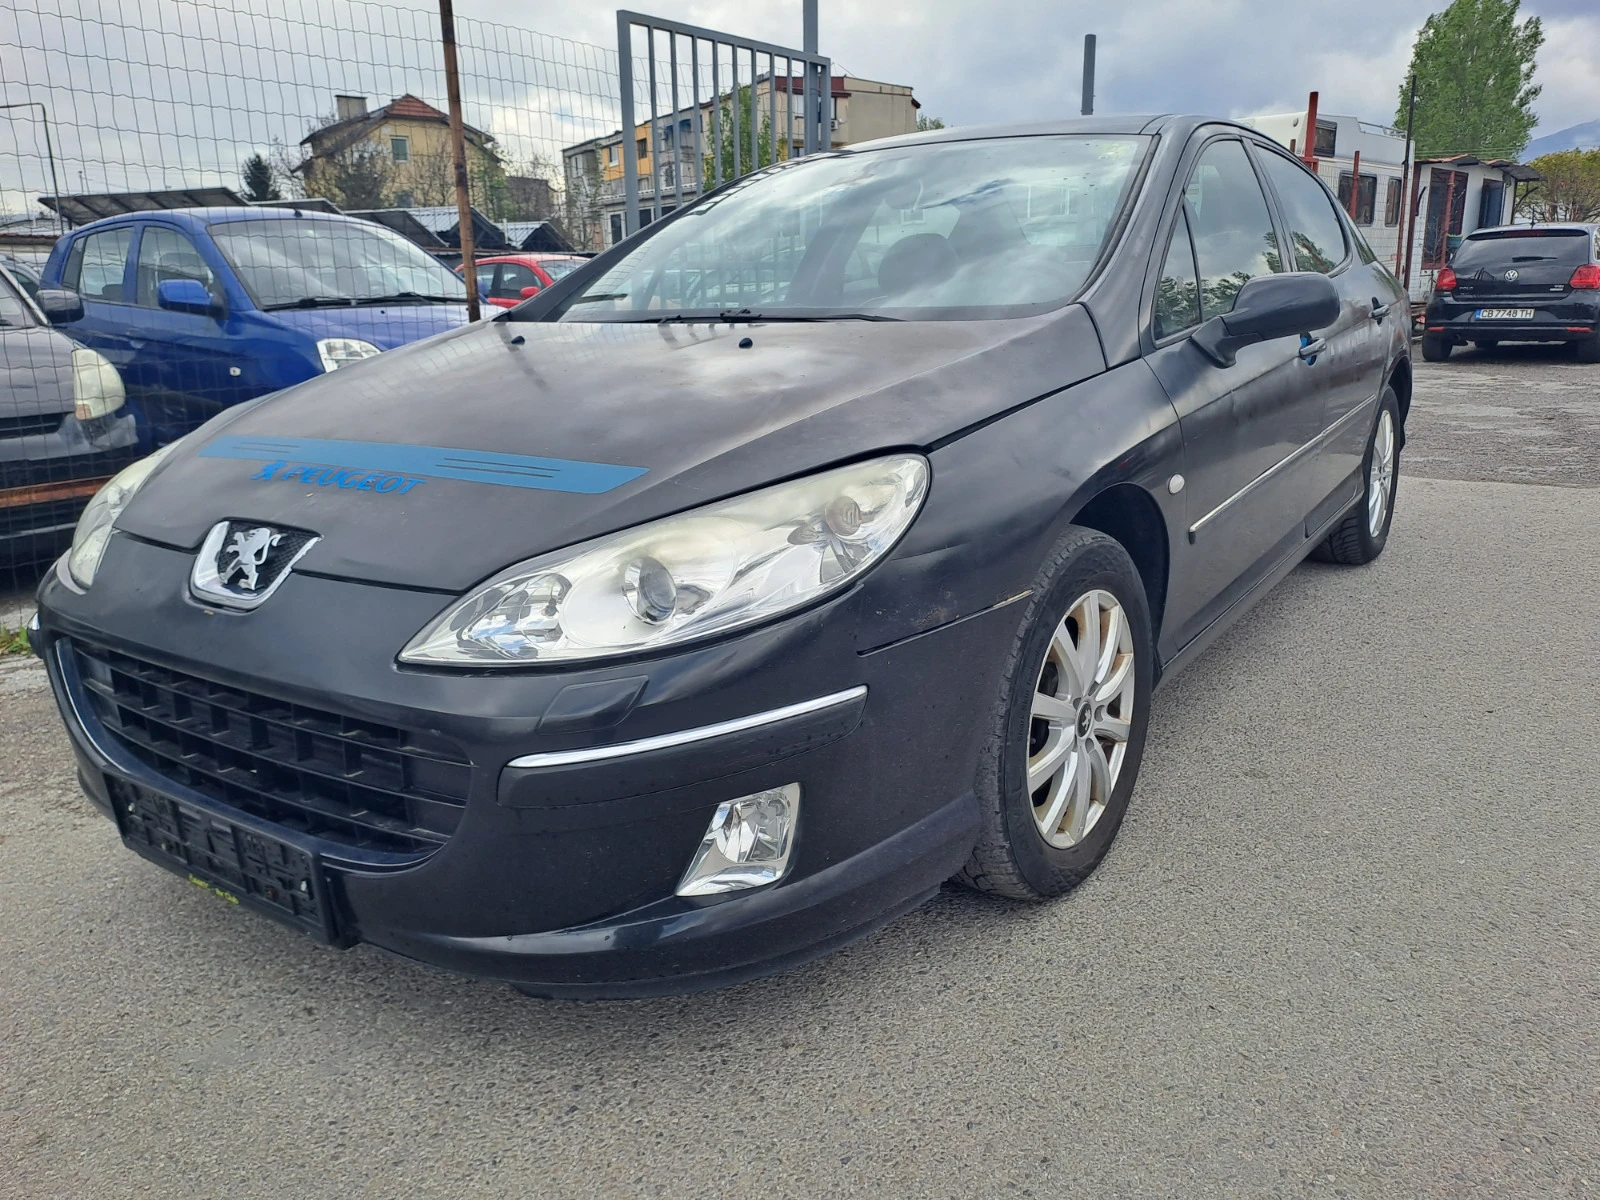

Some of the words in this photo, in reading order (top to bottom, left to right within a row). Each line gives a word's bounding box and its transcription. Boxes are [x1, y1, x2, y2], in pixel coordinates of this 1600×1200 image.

[1481, 309, 1494, 318] CB
[1495, 309, 1518, 318] 7748
[1520, 309, 1533, 318] TH
[282, 466, 426, 494] PEUGEOT
